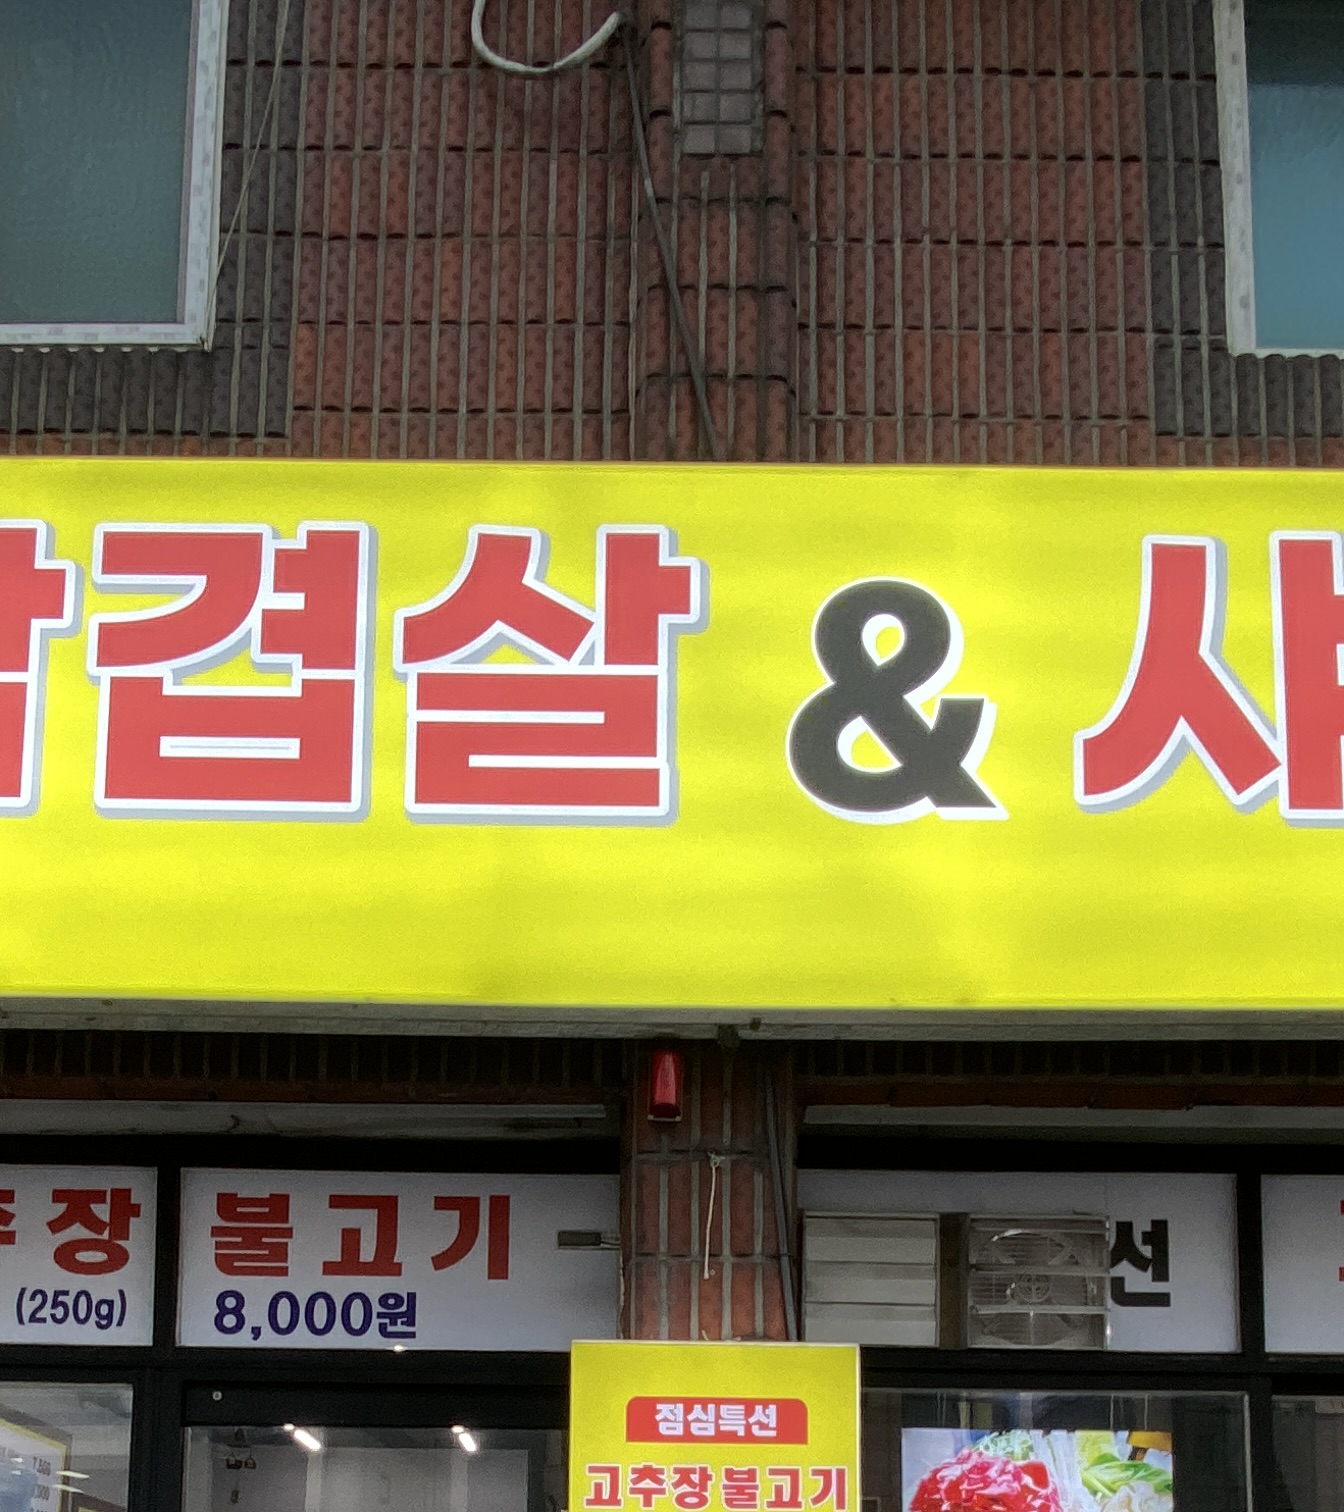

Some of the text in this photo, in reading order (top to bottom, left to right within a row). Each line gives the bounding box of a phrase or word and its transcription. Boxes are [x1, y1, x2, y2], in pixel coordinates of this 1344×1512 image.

[789, 578, 1008, 823] &
[209, 1192, 511, 1280] 불고기
[16, 1286, 417, 1341] (250g) 8,000원
[655, 1403, 777, 1437] 점심특선
[585, 1464, 849, 1511] 고추장 불고기
